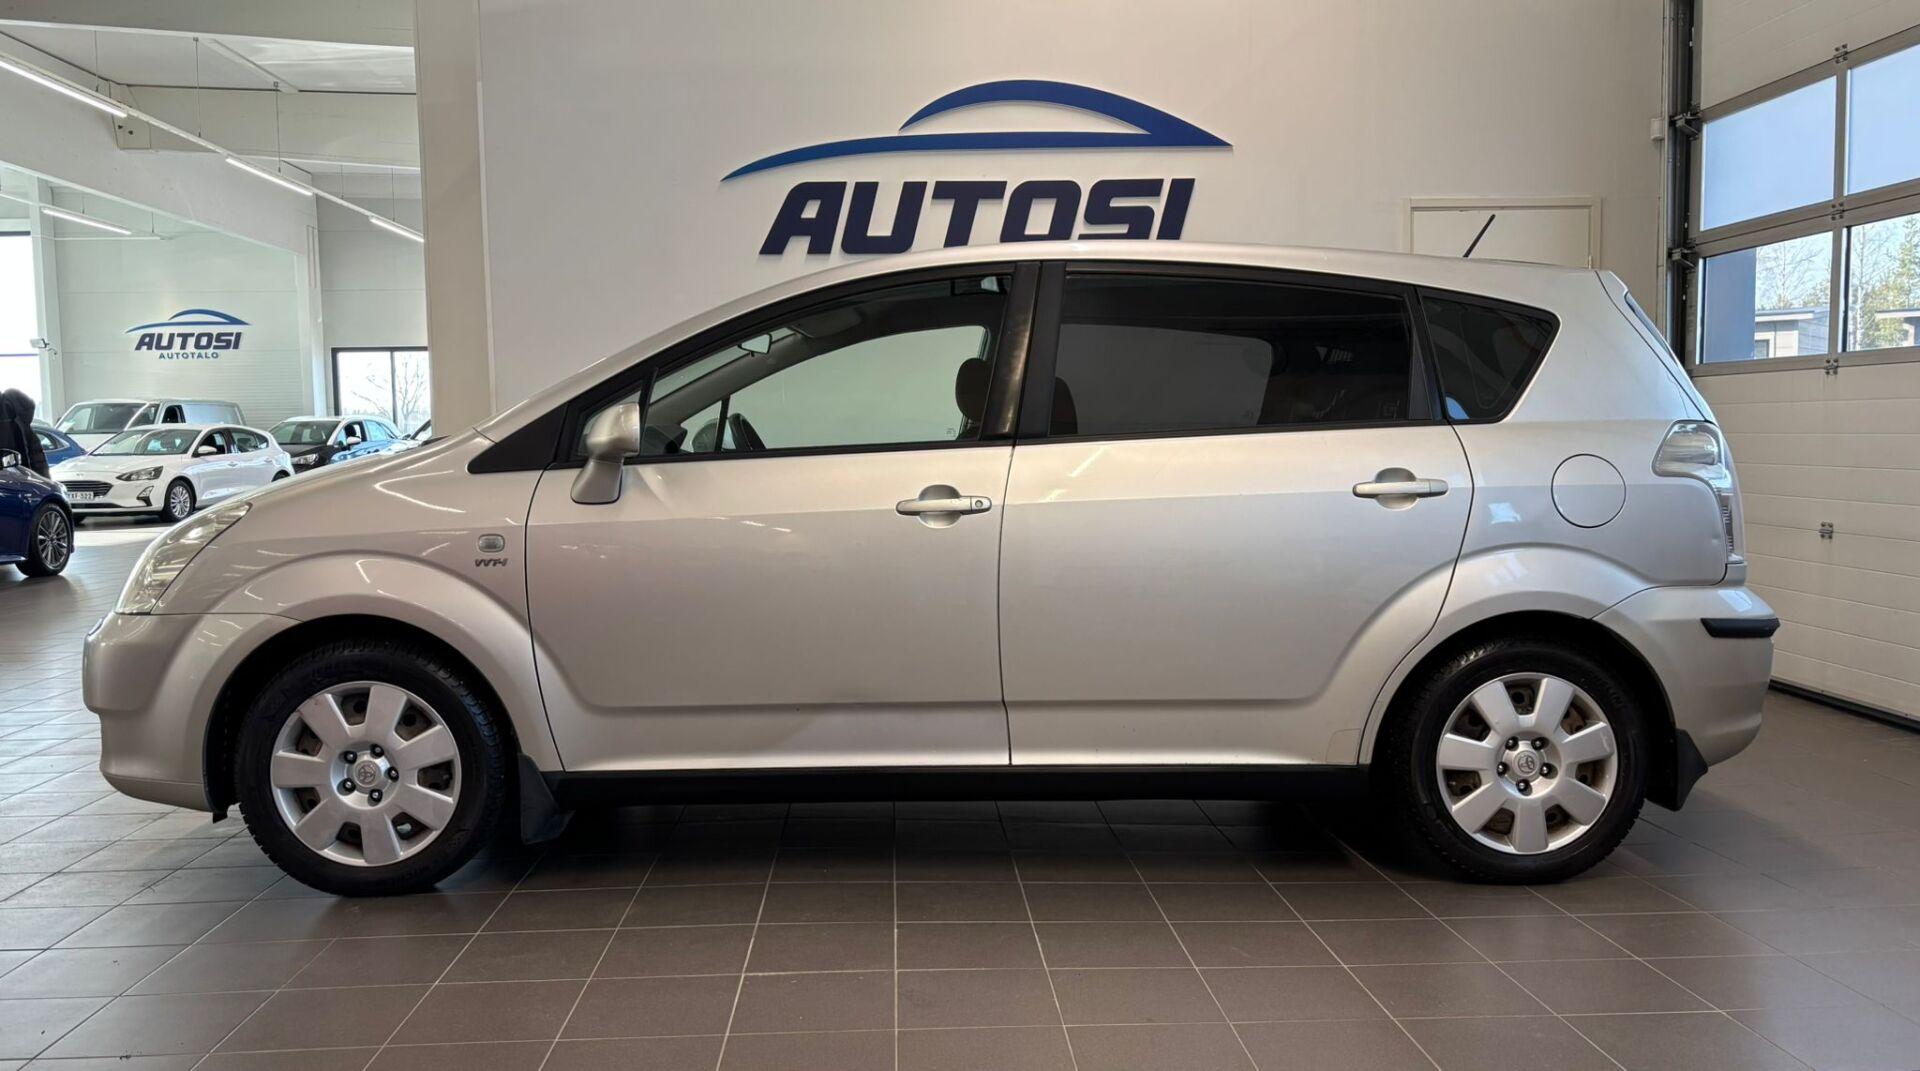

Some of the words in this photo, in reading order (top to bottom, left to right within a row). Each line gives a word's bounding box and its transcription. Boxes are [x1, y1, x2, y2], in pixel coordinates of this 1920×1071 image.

[759, 177, 1195, 255] AUTOSI
[134, 331, 242, 351] AUTOSI
[159, 352, 219, 360] AUTOTALO
